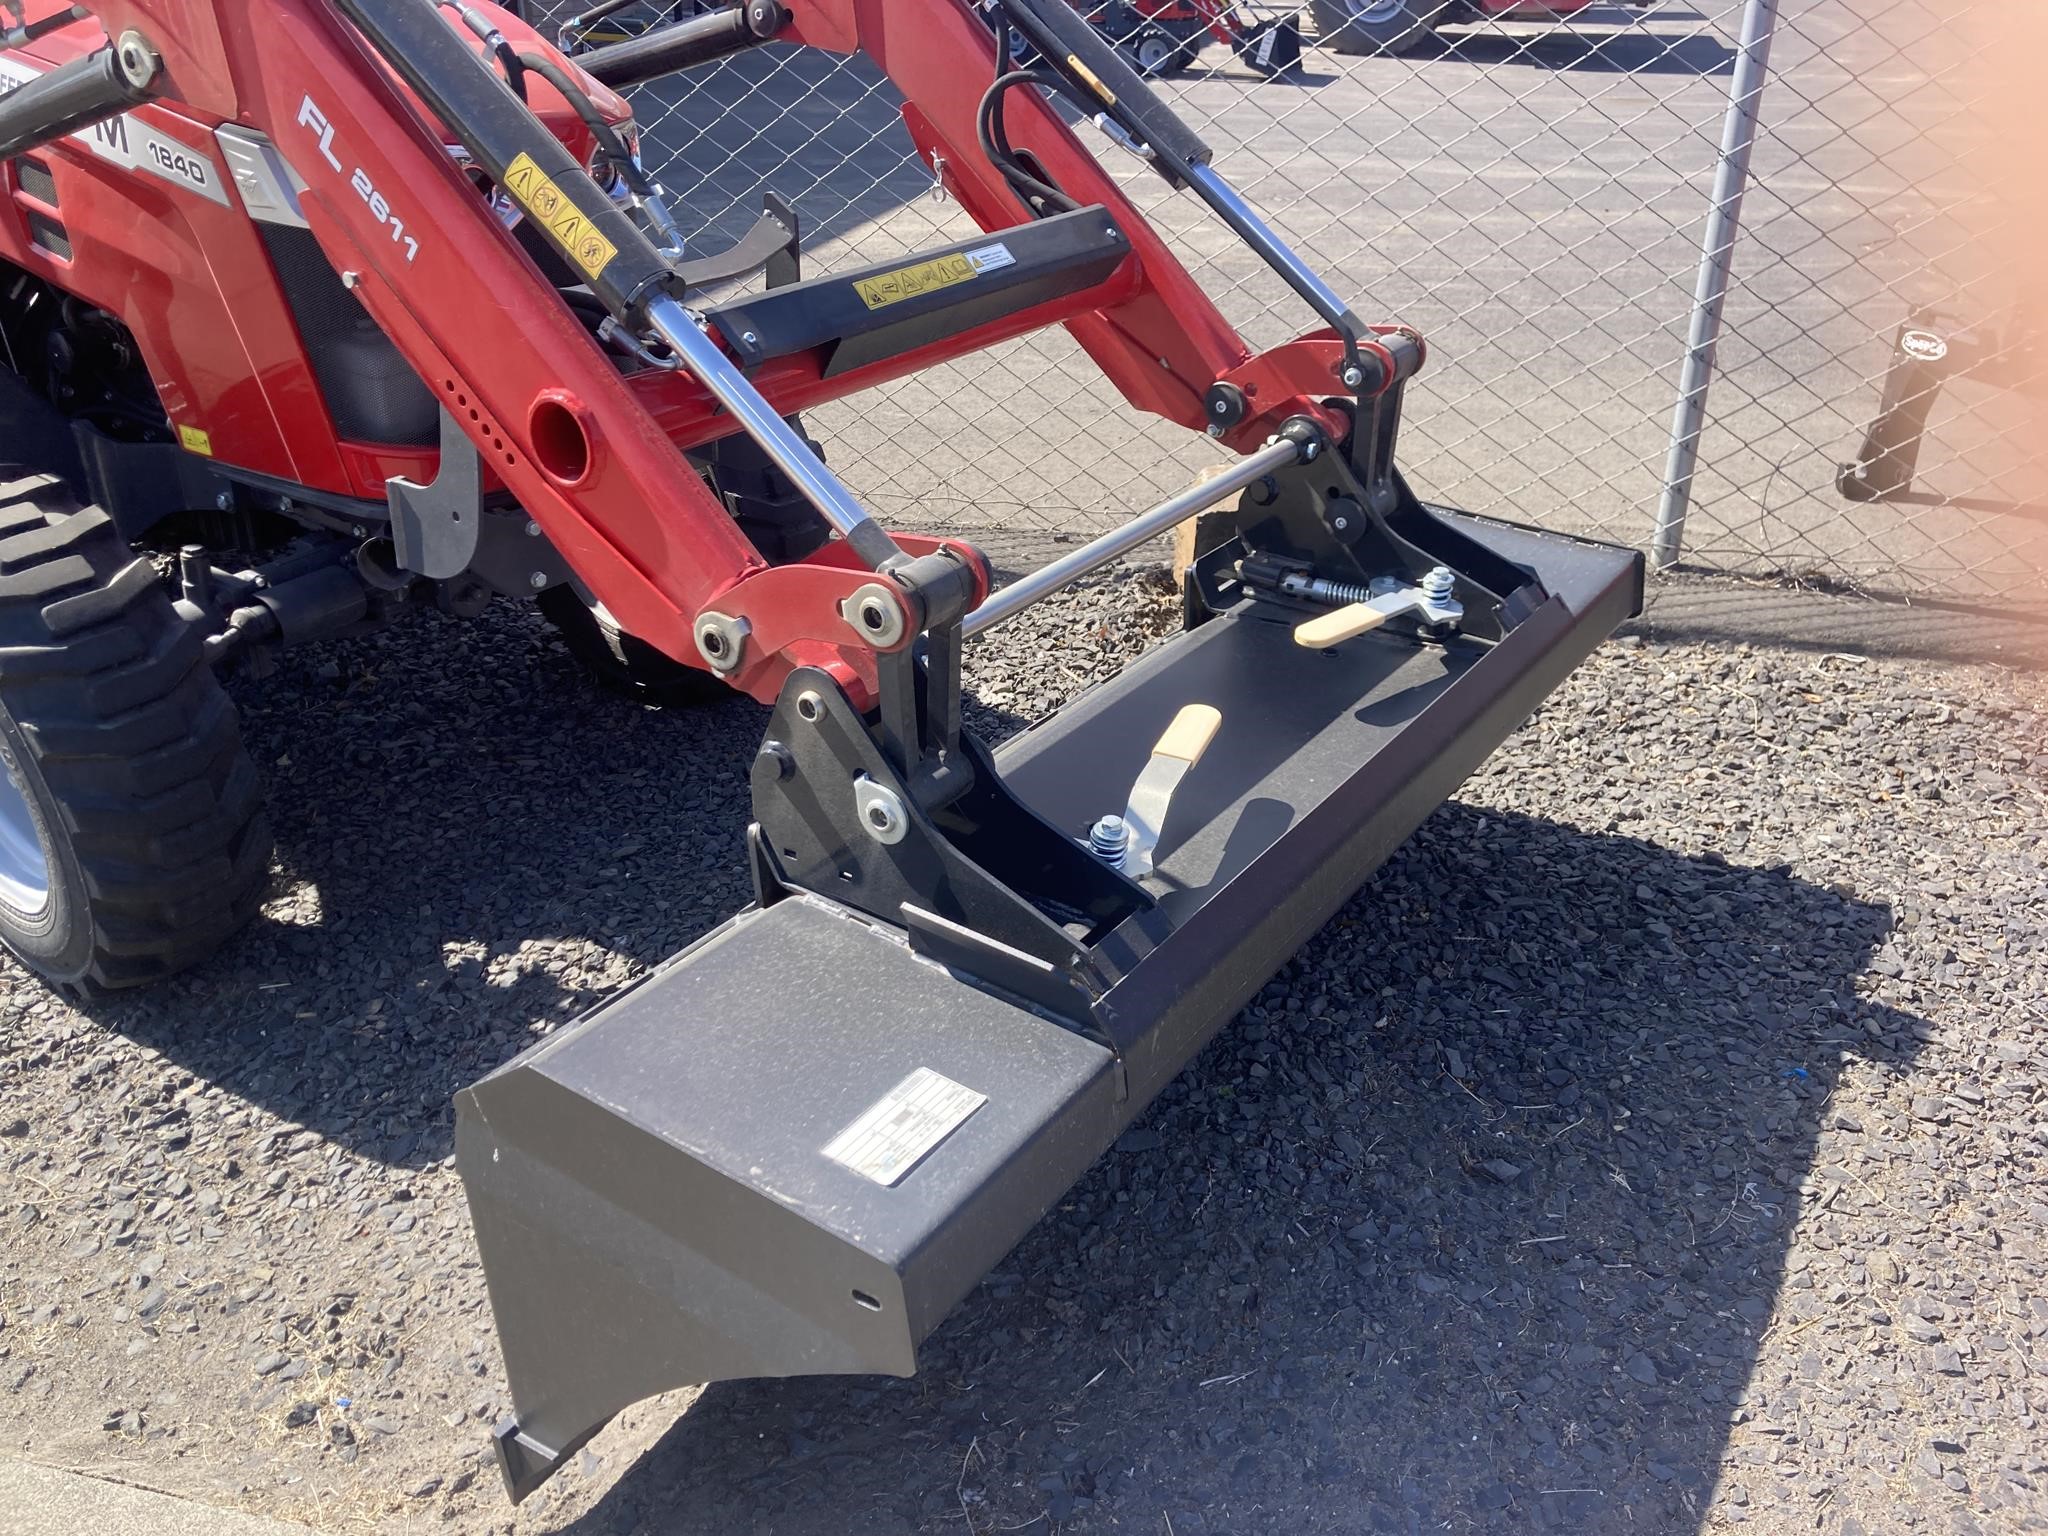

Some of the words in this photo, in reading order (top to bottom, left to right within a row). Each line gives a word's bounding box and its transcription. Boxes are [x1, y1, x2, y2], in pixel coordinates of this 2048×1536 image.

[148, 142, 206, 185] 1840
[297, 94, 342, 173] FL
[351, 167, 419, 262] 2611
